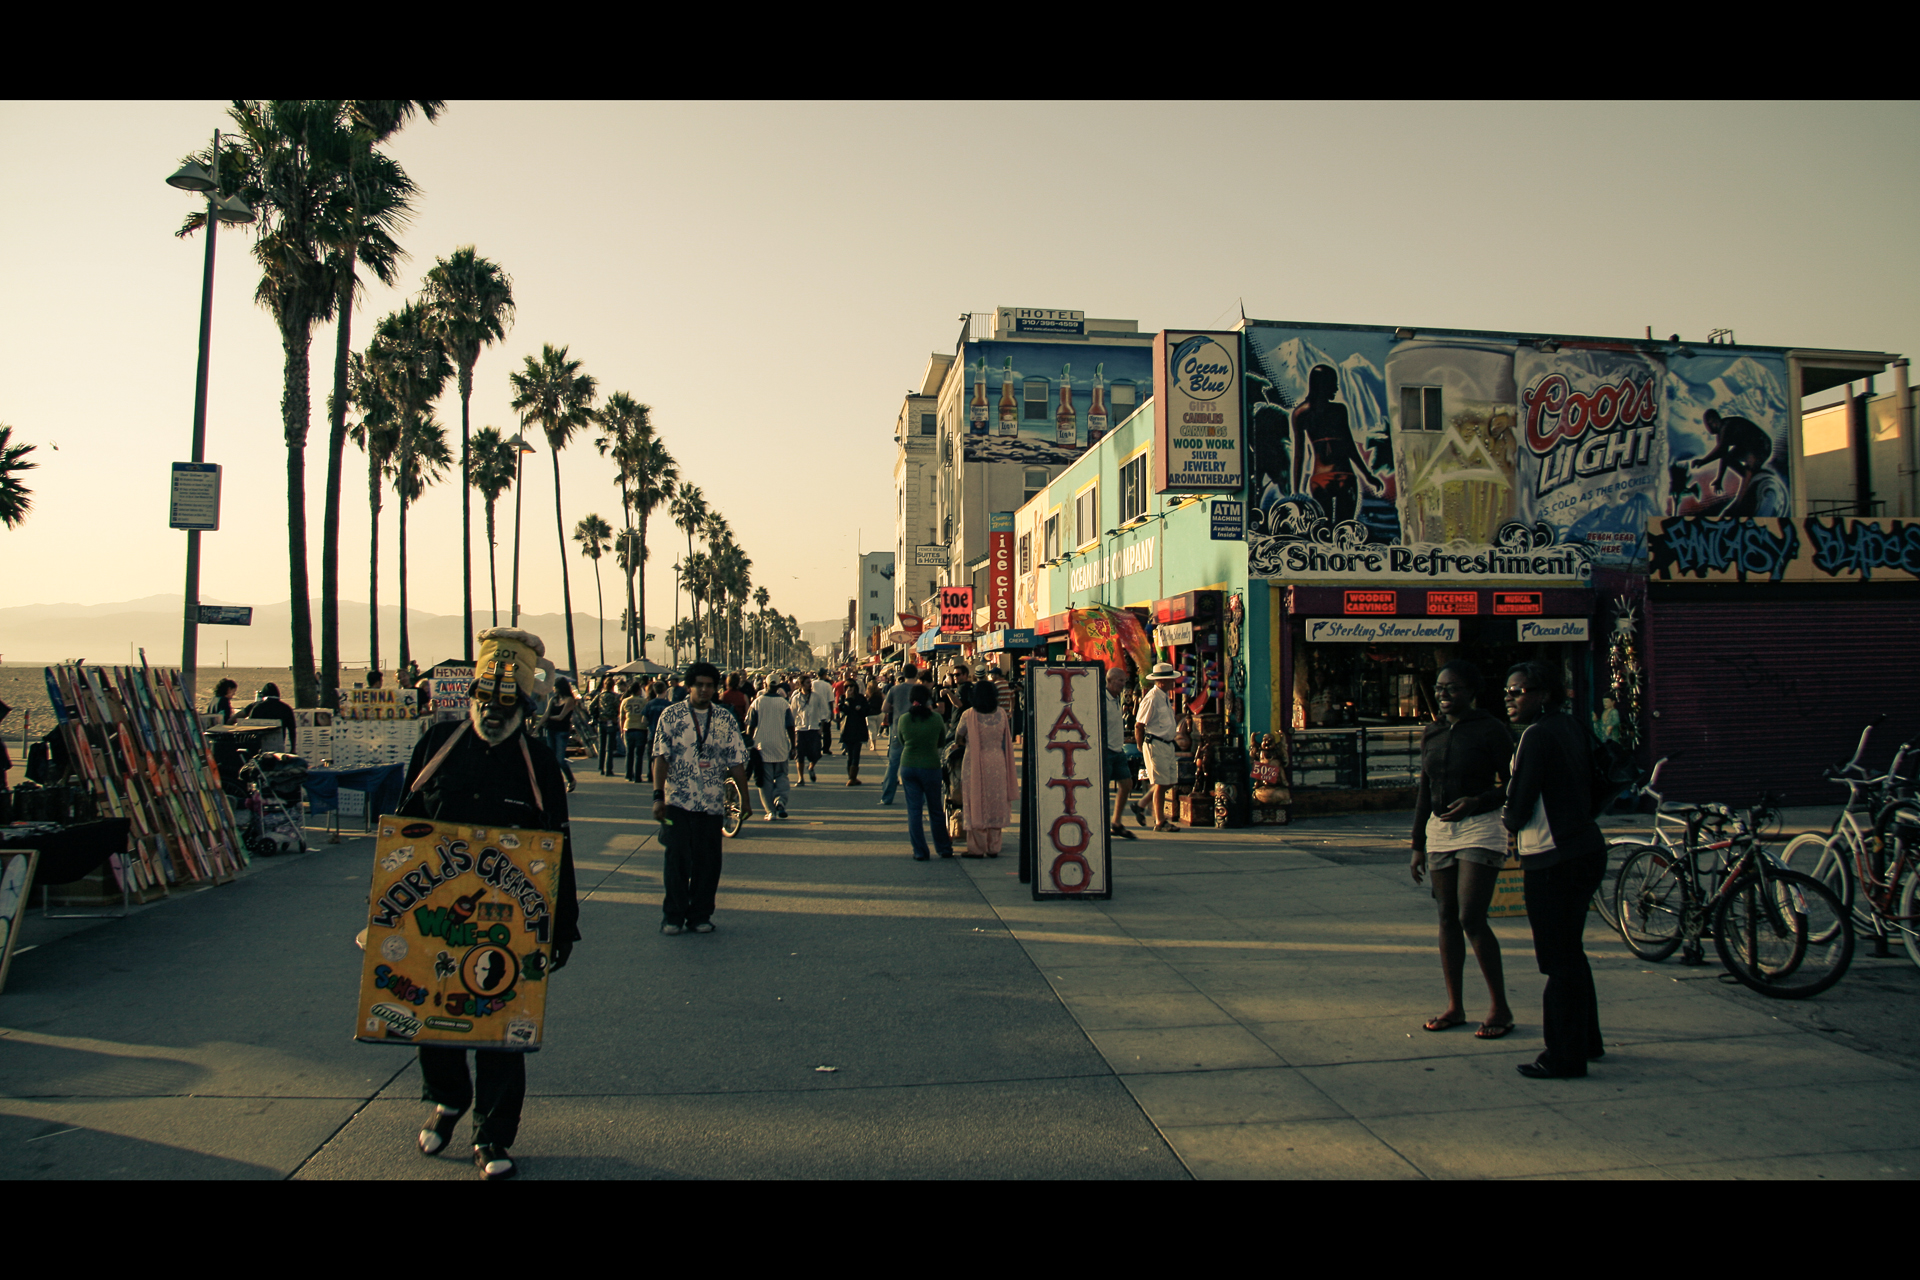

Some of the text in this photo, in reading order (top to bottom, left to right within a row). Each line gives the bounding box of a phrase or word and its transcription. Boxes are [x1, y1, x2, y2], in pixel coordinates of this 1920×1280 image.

[1021, 309, 1079, 320] HOTEL
[1184, 357, 1229, 375] Ocean
[1189, 373, 1226, 393] Blue
[1189, 401, 1217, 412] GIFTS
[1182, 412, 1224, 424] CANDLES
[1522, 373, 1658, 456] Coors
[1179, 425, 1228, 437] CARVINGS
[1173, 438, 1235, 450] WOOD WORK
[1191, 451, 1218, 460] SILVER
[1182, 461, 1226, 472] JEWELRY
[1536, 426, 1656, 499] LIGHT
[1168, 473, 1241, 485] AROMATHERAPY
[1537, 506, 1549, 519] AS
[1551, 496, 1577, 513] COLD
[1580, 490, 1593, 503] AS
[1596, 484, 1613, 497] THE
[1213, 503, 1241, 516] ATM
[1212, 514, 1242, 522] MACHINE
[1212, 525, 1241, 533] Available
[1217, 531, 1237, 539] Inside
[1586, 532, 1635, 542] BEACH GEAR
[1600, 545, 1622, 554] HERE
[1070, 562, 1093, 594] OCEAN
[1111, 536, 1156, 581] COMPANY
[1285, 546, 1576, 576] Shore Refreshment
[994, 534, 1010, 631] ice cream
[942, 590, 969, 609] toe
[1349, 593, 1392, 603] WOODEN
[1429, 594, 1475, 603] INCENSE
[1503, 595, 1532, 604] MUSICAL
[1346, 602, 1394, 612] CARVINGS
[1496, 603, 1540, 612] INSTRUMENTS
[942, 609, 971, 630] rings
[1329, 621, 1454, 641] Sterling Silver Jewelry
[1531, 622, 1585, 637] Ocean Blue
[494, 648, 518, 660] GOT
[436, 668, 474, 678] HENNA
[353, 690, 396, 704] HENNA
[1252, 764, 1278, 777] 50%
[1044, 668, 1095, 893] TATTOO
[475, 847, 551, 943] GREATEST
